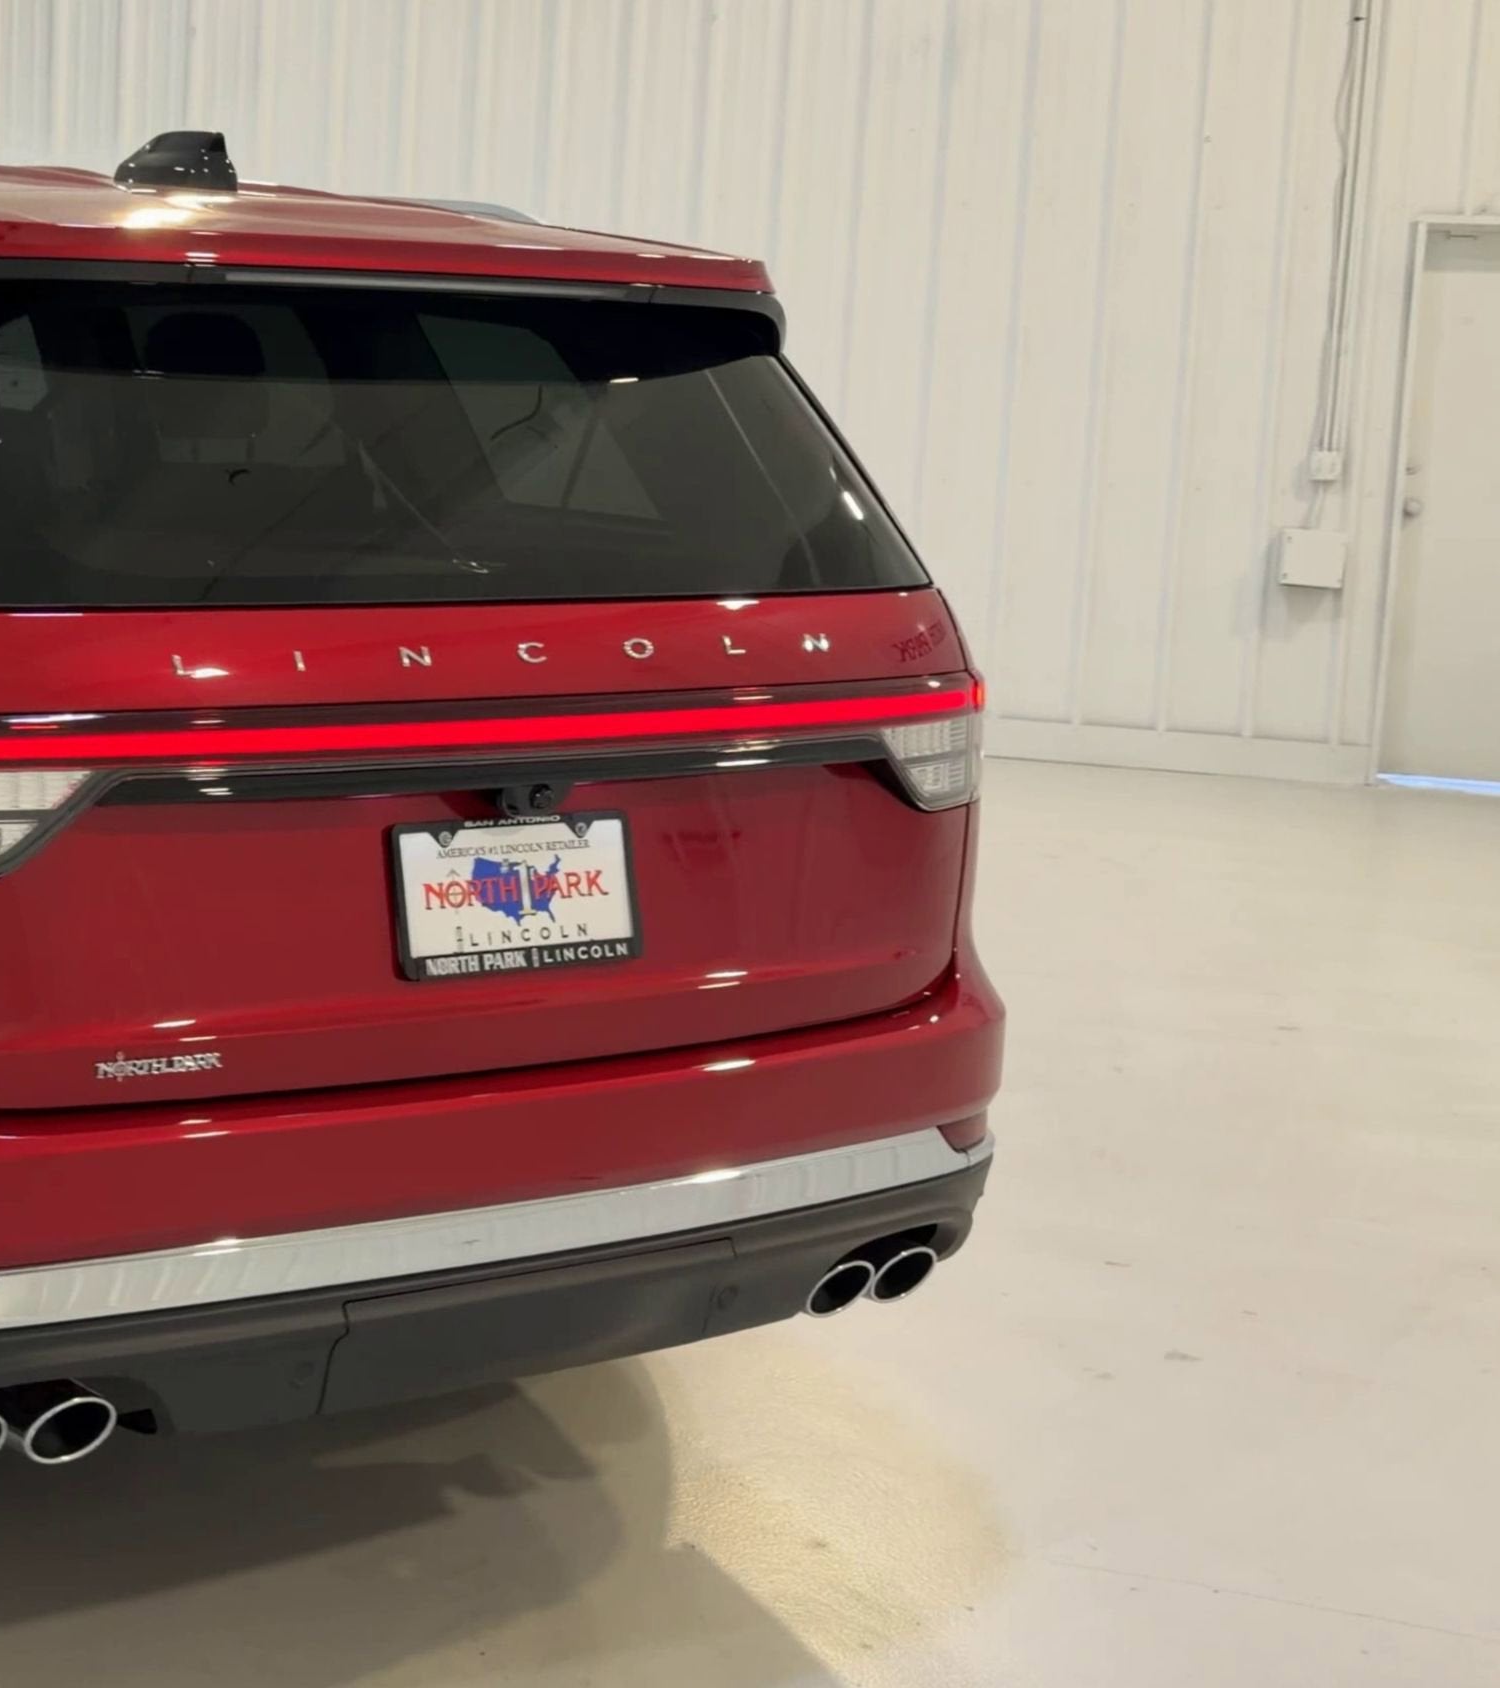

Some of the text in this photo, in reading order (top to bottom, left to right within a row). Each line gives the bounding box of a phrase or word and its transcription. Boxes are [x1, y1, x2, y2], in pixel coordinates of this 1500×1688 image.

[171, 633, 830, 676] LINCOLN
[464, 814, 561, 829] SAN ANTONIO
[499, 841, 545, 855] LINCOLN
[546, 839, 591, 852] RETAILER
[423, 869, 609, 910] NORTH PARK
[469, 923, 589, 946] LINCOLN
[425, 942, 629, 976] NORTH PARK LINCOLN
[95, 1052, 223, 1080] NORTH PARK
